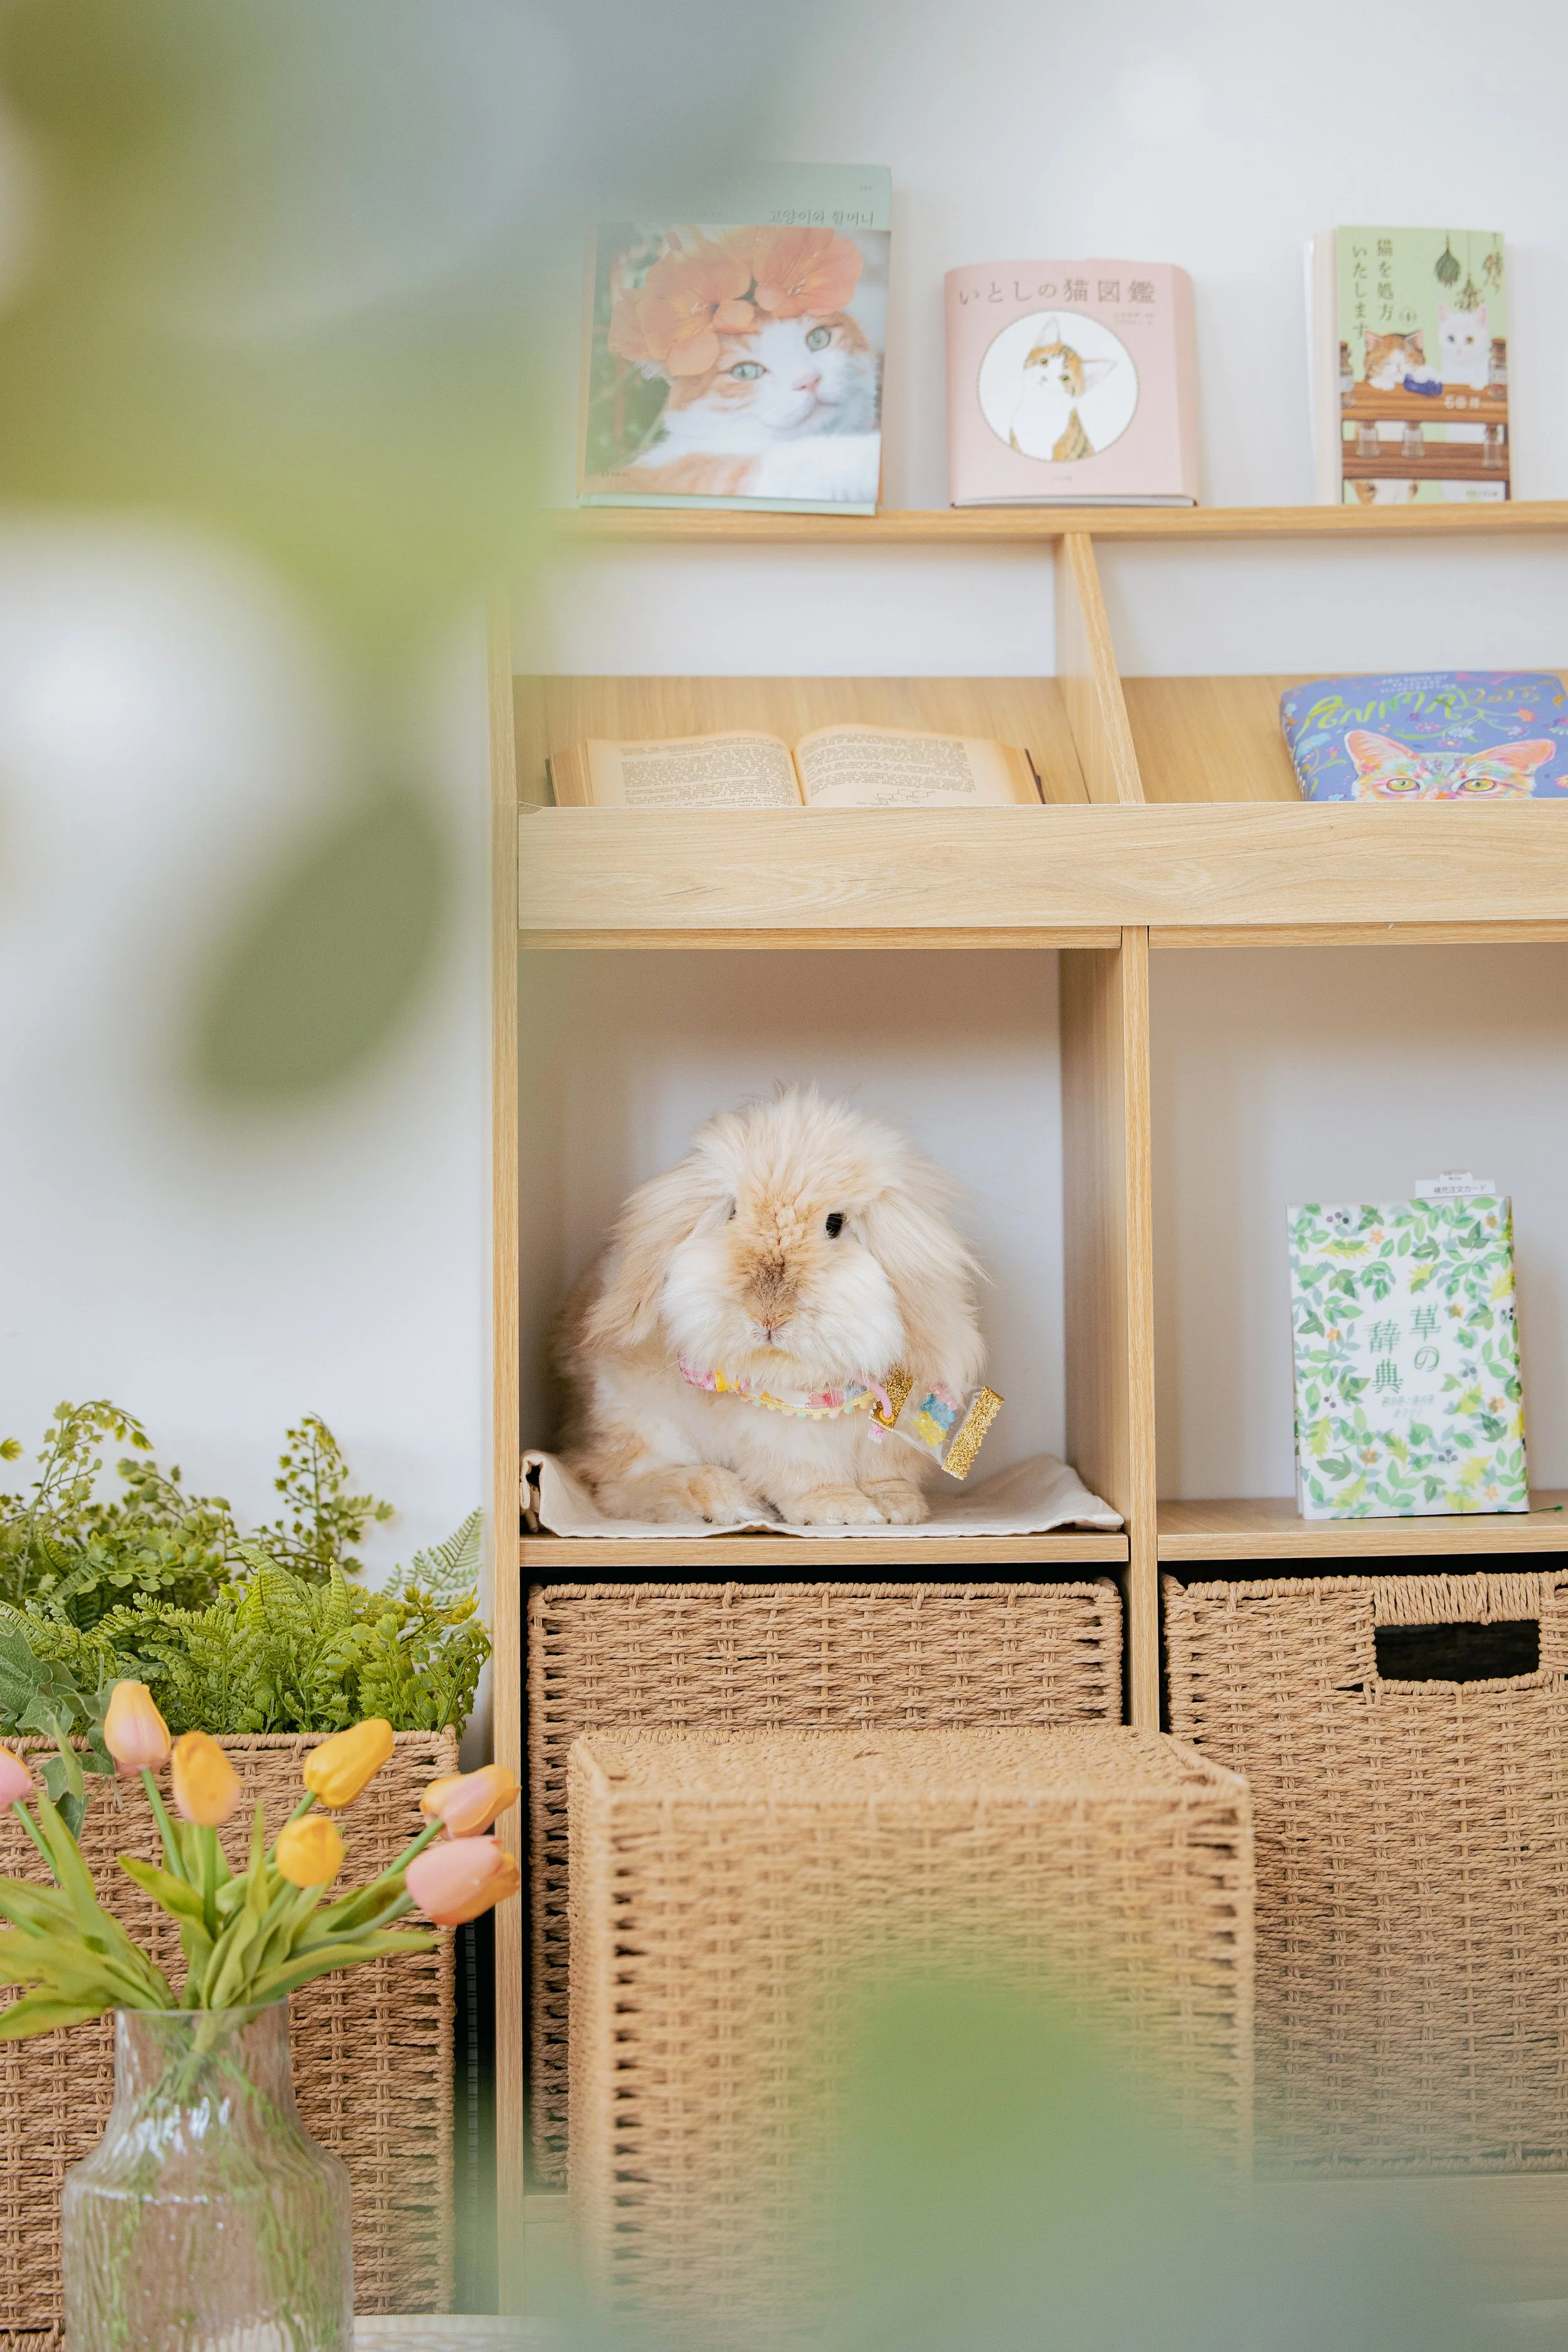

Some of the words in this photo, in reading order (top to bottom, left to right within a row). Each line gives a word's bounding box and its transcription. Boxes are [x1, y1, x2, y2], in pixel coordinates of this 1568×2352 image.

[959, 277, 1156, 305] いとしの猫図鑑
[1364, 1319, 1404, 1394] 辞典
[1409, 1301, 1442, 1372] 草の
